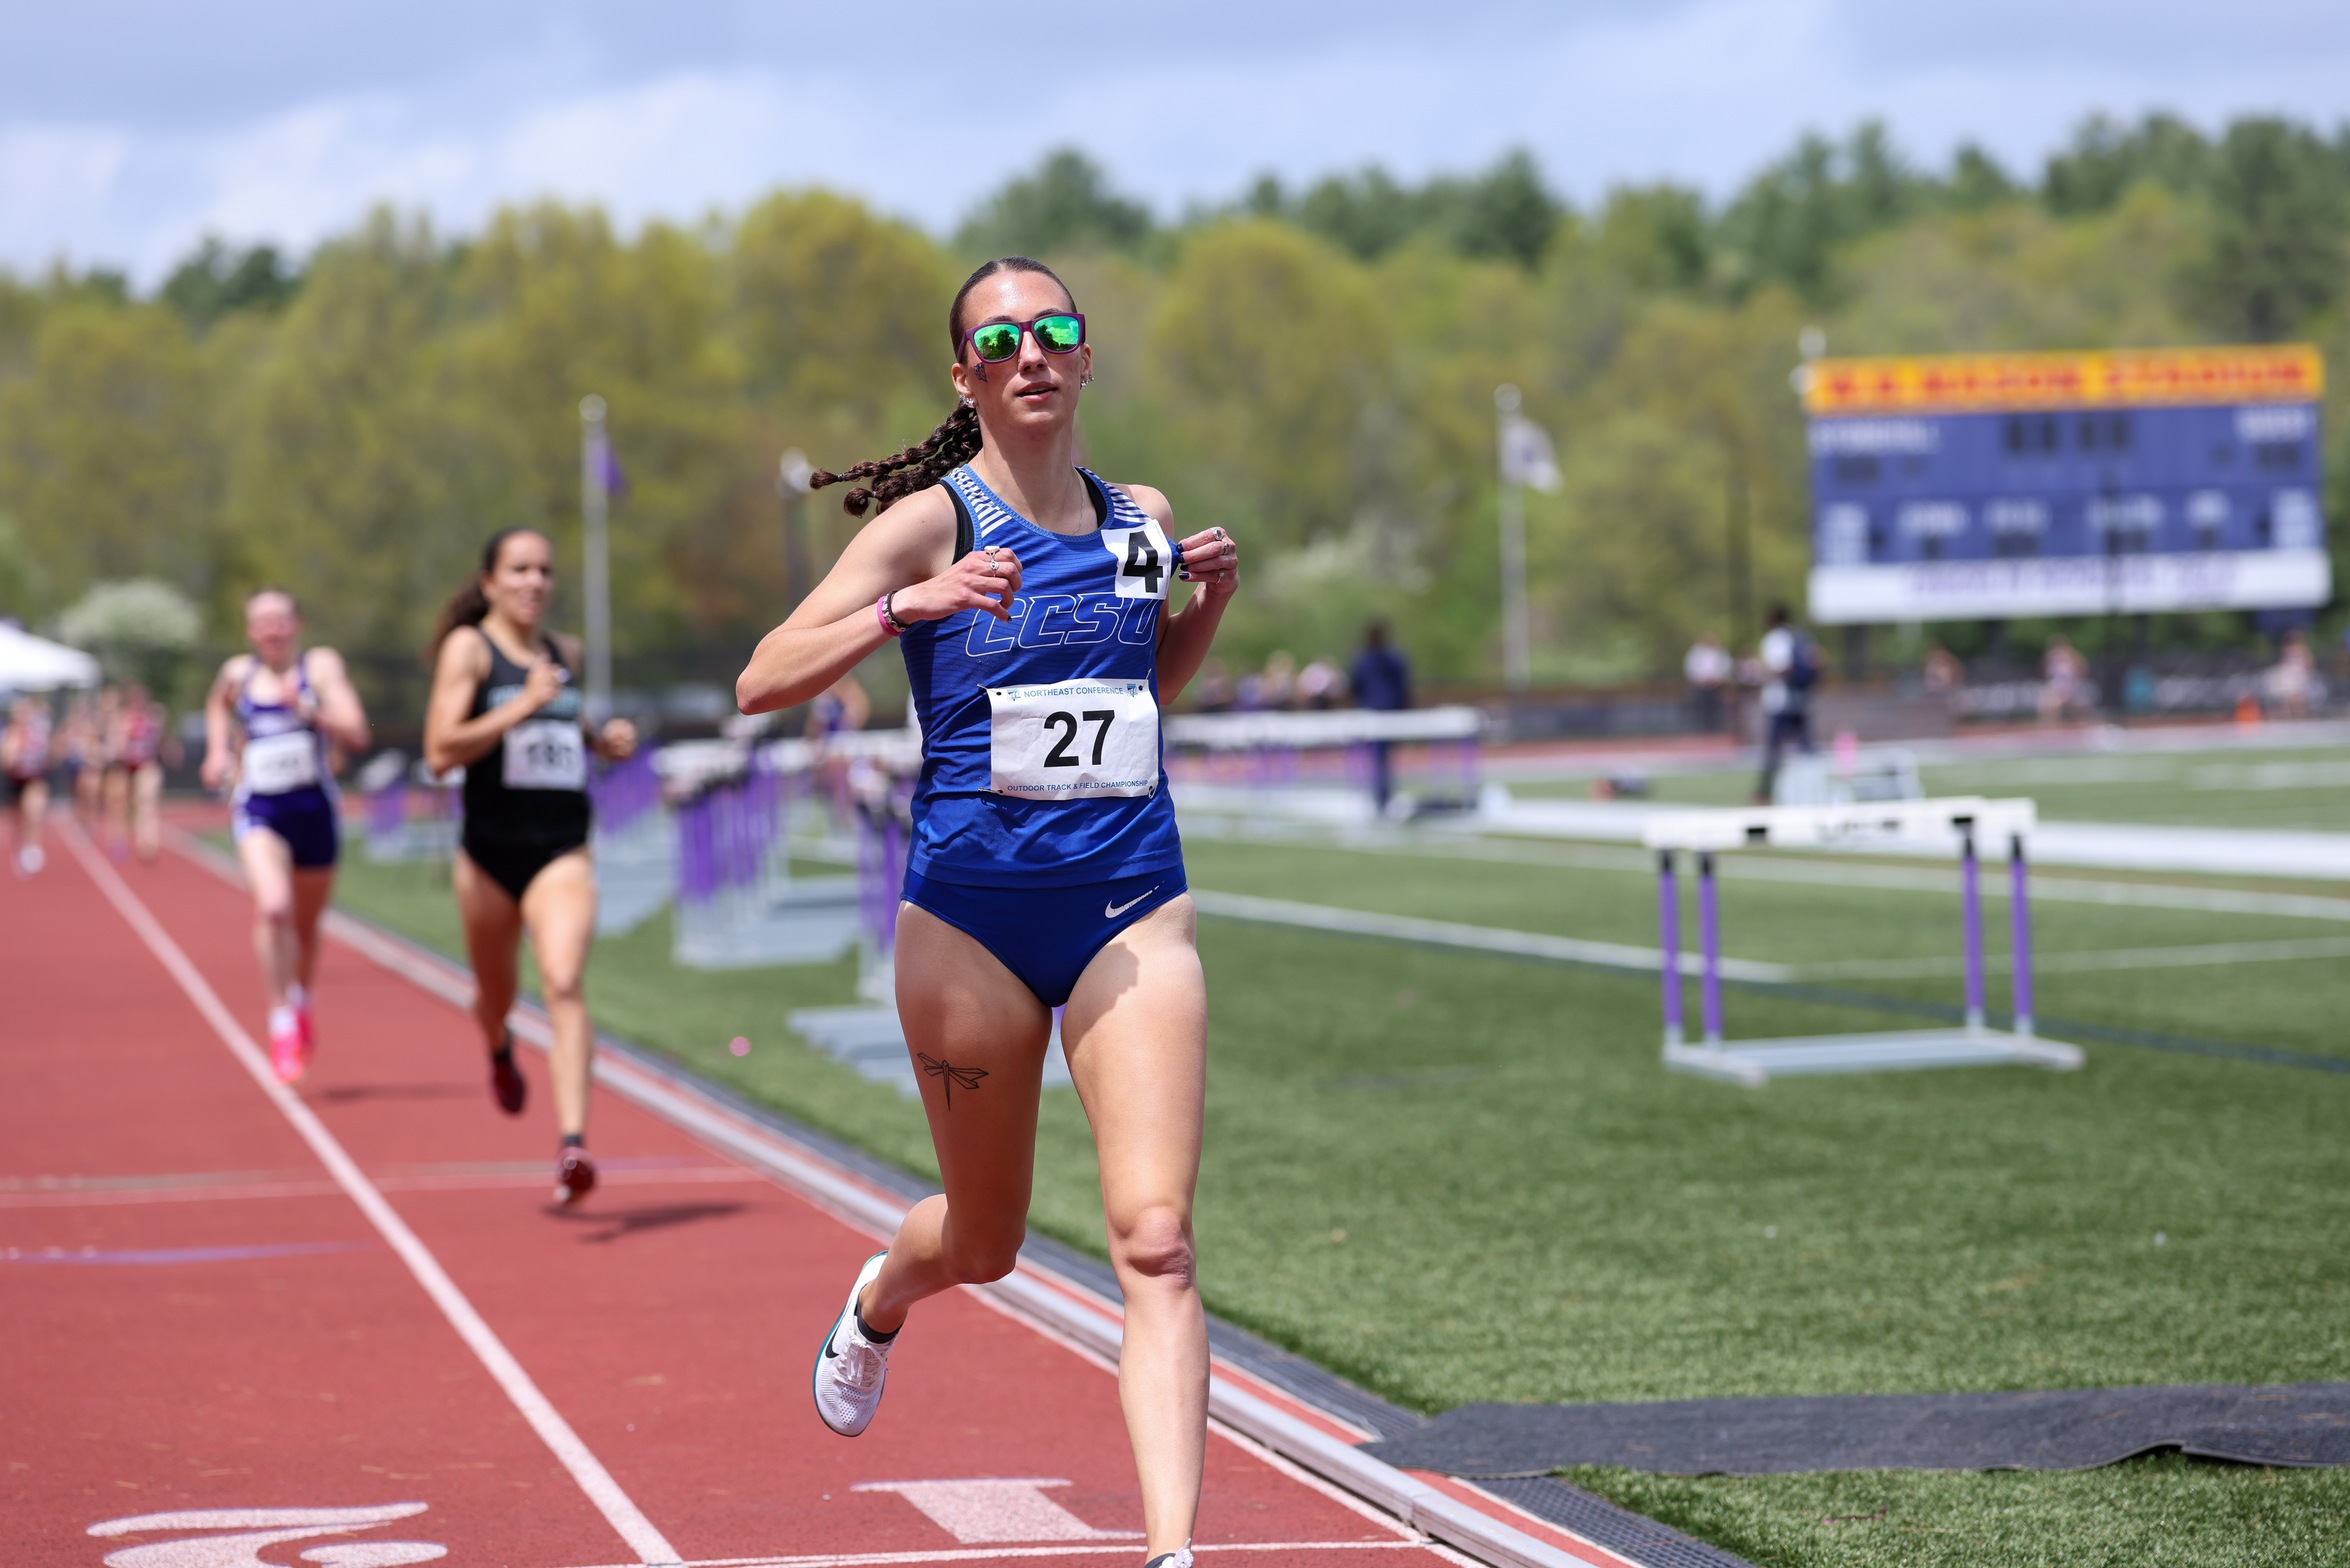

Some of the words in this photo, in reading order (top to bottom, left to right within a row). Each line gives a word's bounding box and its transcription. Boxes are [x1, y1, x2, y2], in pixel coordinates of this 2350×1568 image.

[1122, 530, 1164, 594] 4
[965, 592, 1158, 657] CCSU
[1023, 687, 1074, 698] NORTHEAST
[1075, 686, 1124, 695] CONFERENCE
[1043, 709, 1116, 768] 27
[1046, 783, 1072, 791] TRACK
[1101, 779, 1149, 788] CHAMPIONSHIP
